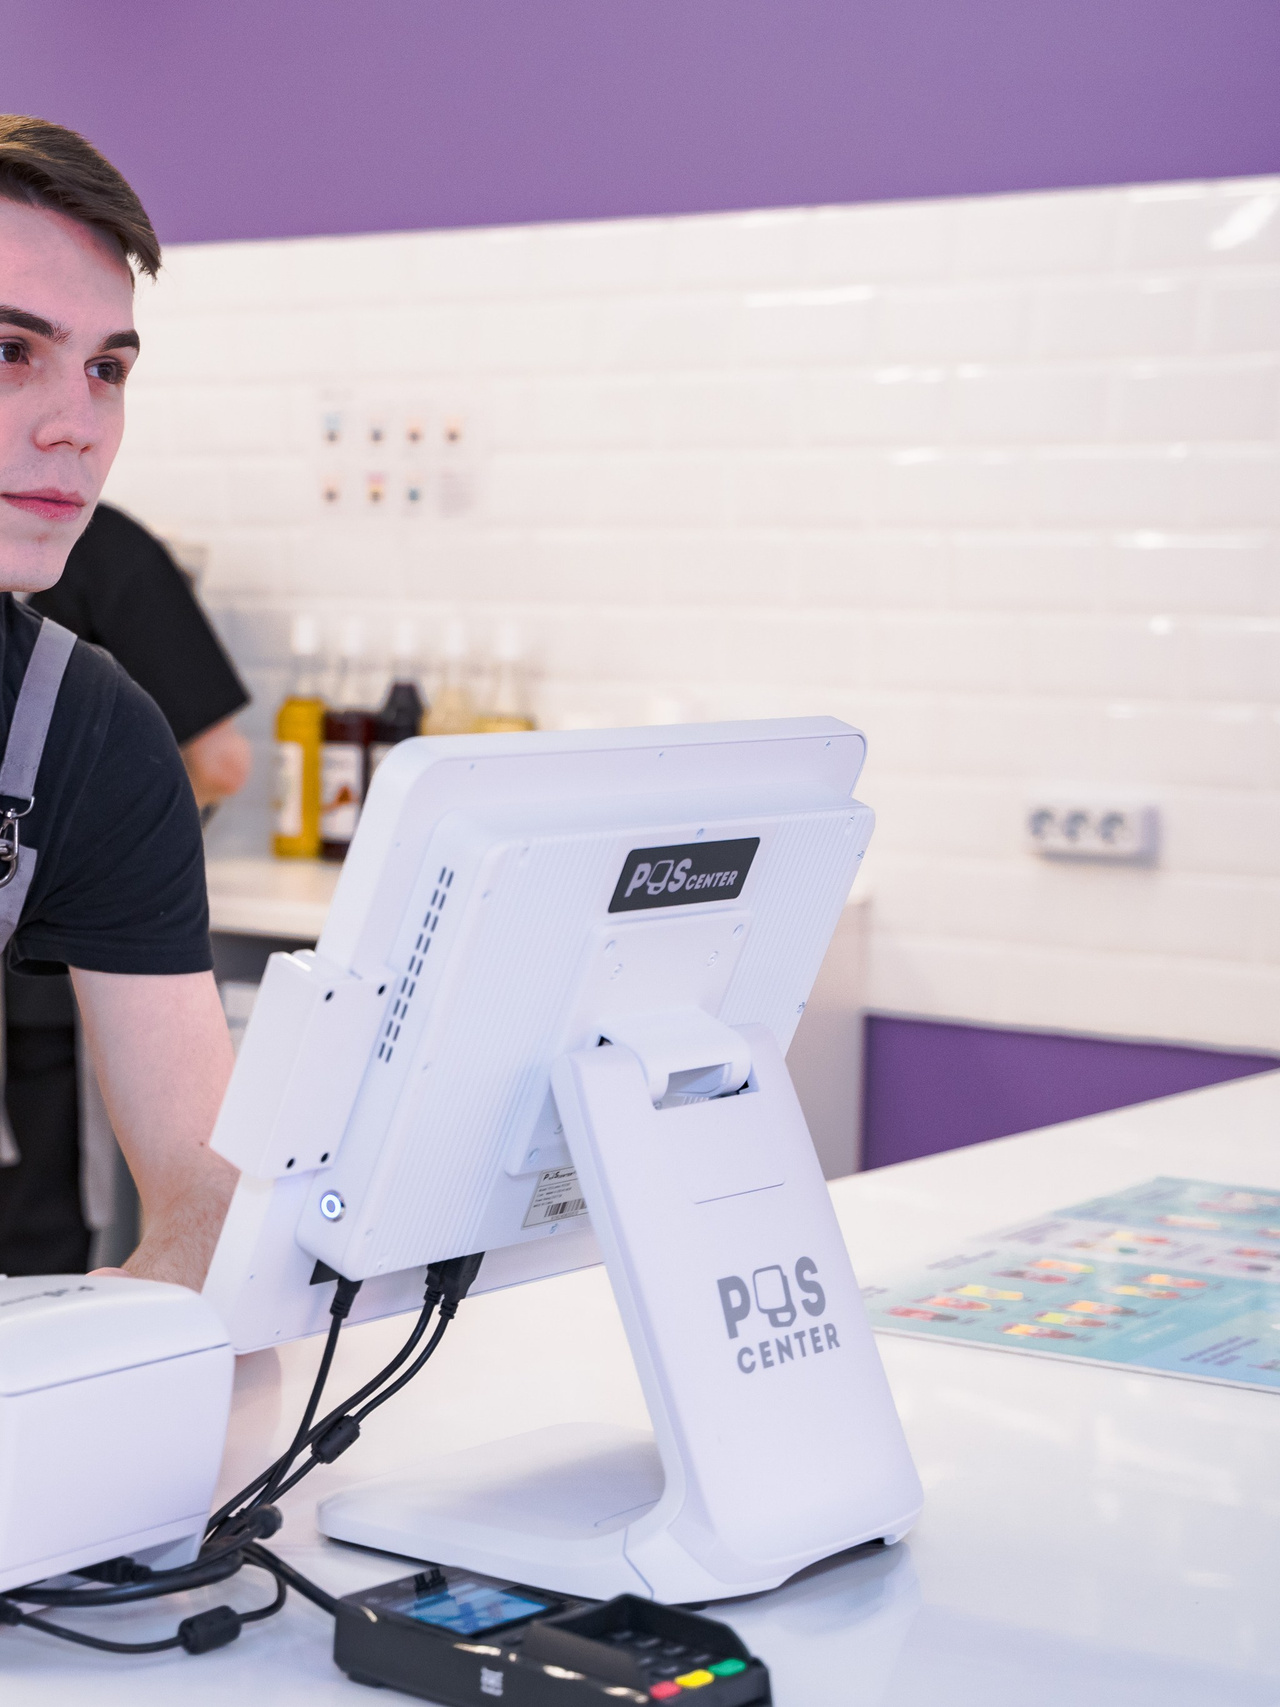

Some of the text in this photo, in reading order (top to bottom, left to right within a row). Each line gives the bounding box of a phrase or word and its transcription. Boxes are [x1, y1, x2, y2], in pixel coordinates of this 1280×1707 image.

[623, 858, 739, 898] POS CENTER
[716, 1255, 827, 1340] POS
[736, 1322, 841, 1374] CENTER
